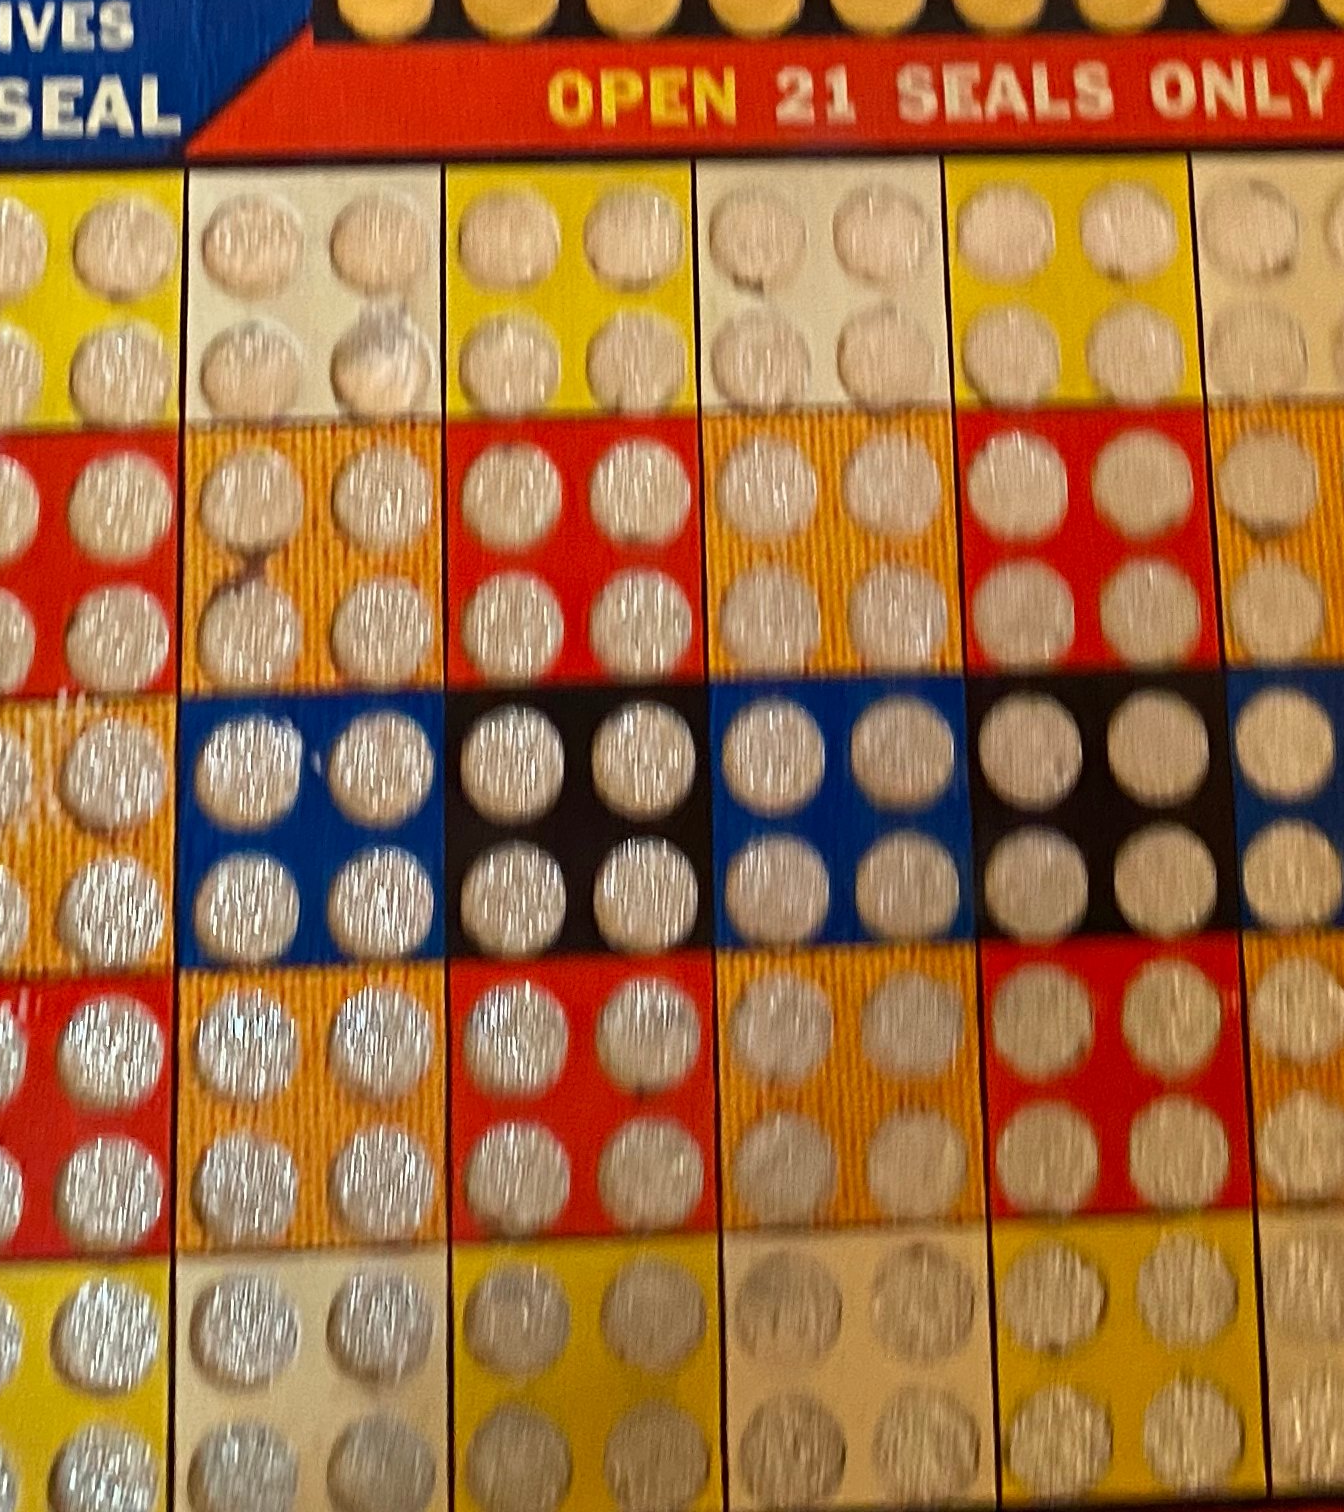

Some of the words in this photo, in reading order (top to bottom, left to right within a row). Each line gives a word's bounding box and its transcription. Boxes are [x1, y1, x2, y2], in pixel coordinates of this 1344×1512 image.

[547, 67, 736, 129] OPEN
[775, 63, 855, 127] 21
[897, 60, 1114, 125] SEALS
[1150, 55, 1336, 121] ONLY
